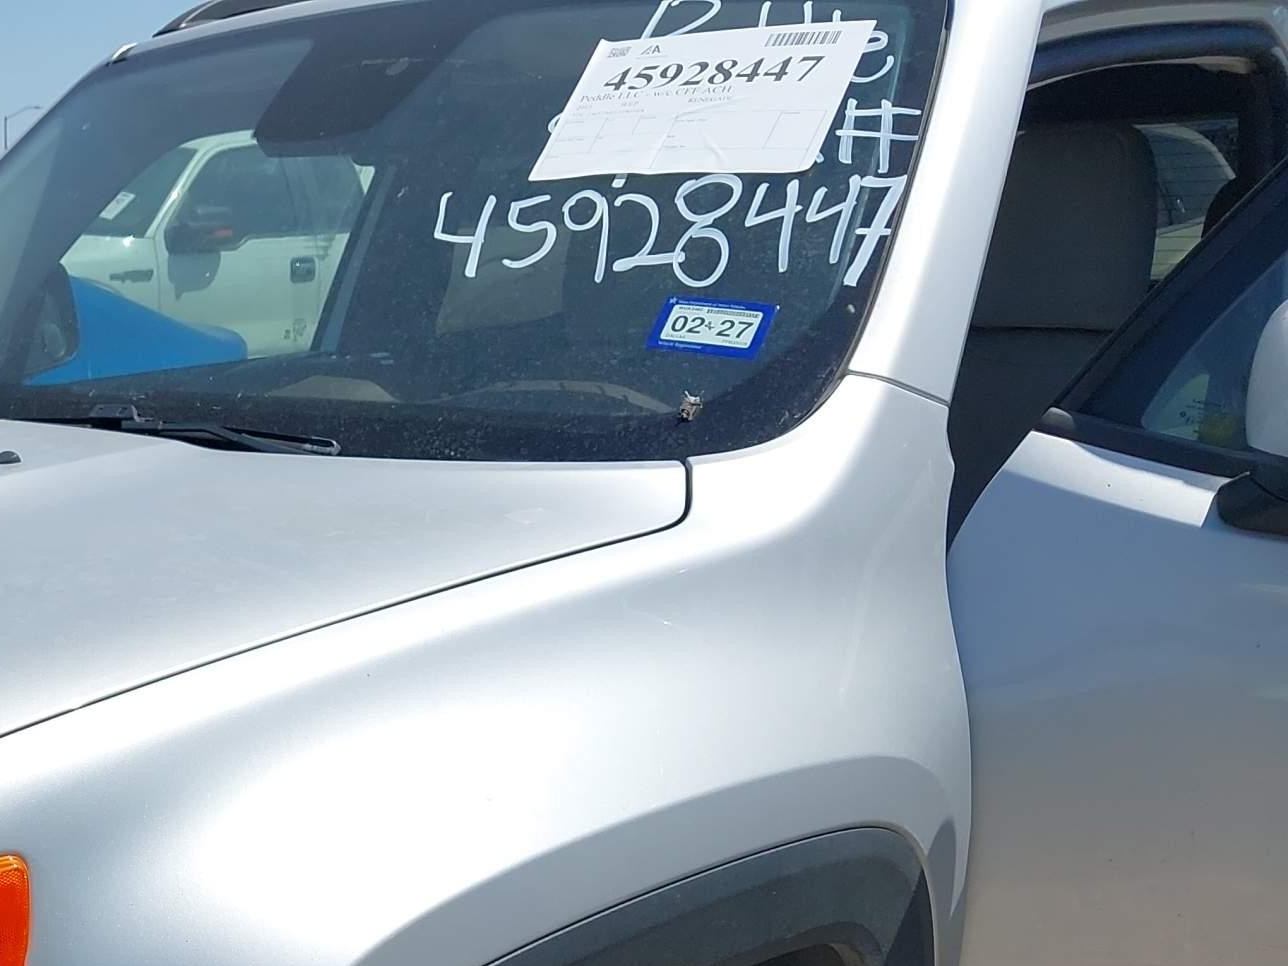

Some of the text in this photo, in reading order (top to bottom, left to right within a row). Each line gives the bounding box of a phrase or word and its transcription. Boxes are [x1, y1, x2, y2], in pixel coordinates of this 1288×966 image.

[603, 55, 826, 91] 45928447
[434, 174, 907, 287] 45928447
[671, 315, 754, 339] 02 27
